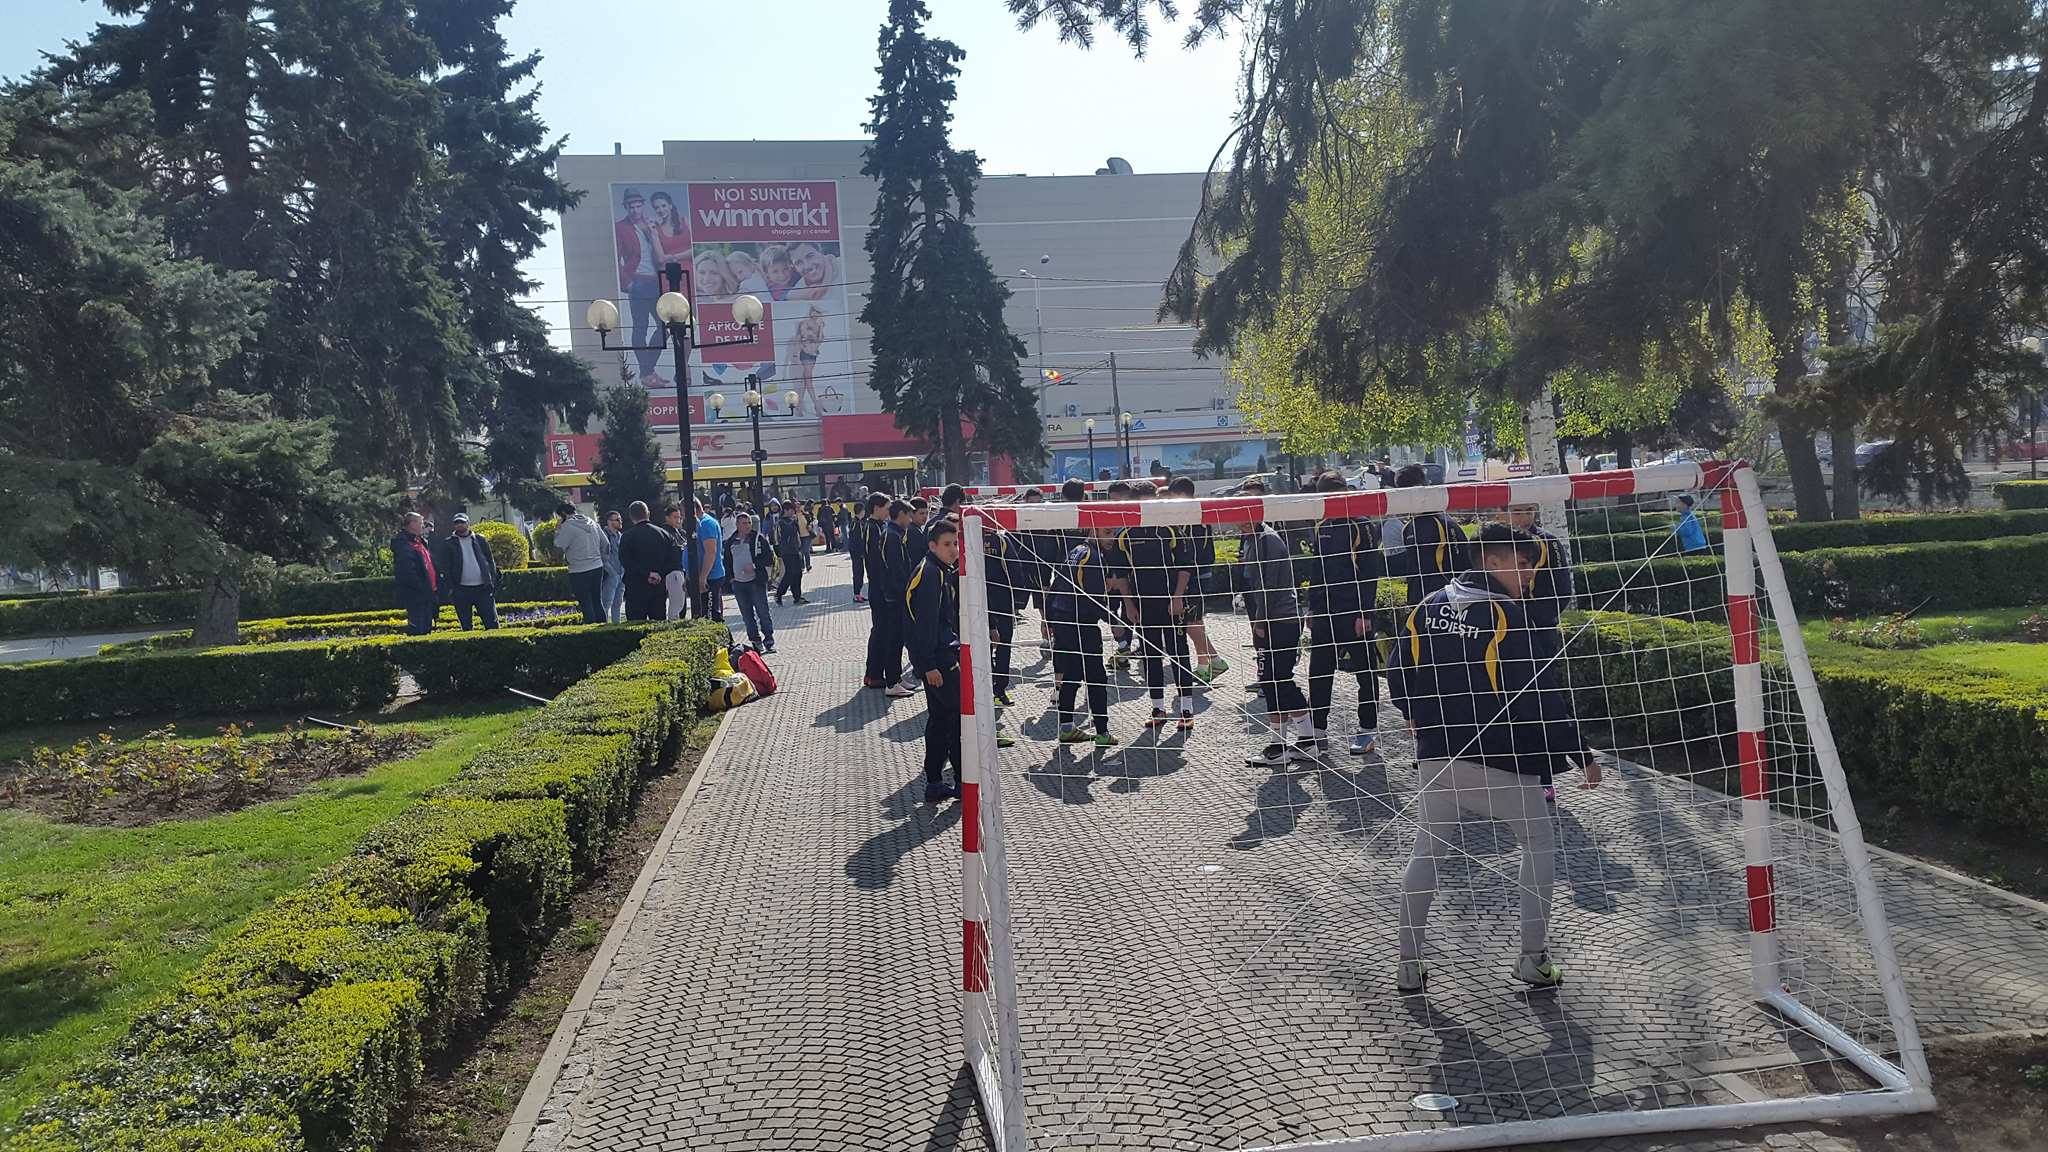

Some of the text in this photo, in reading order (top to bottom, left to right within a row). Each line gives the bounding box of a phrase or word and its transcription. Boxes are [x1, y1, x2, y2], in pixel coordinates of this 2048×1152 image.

[714, 187, 812, 201] NOI SUNTEM
[699, 202, 829, 227] winmarkt
[708, 321, 765, 332] APROE
[647, 405, 696, 416] HOPPIG
[692, 434, 726, 451] FC
[1439, 604, 1469, 622] CSM
